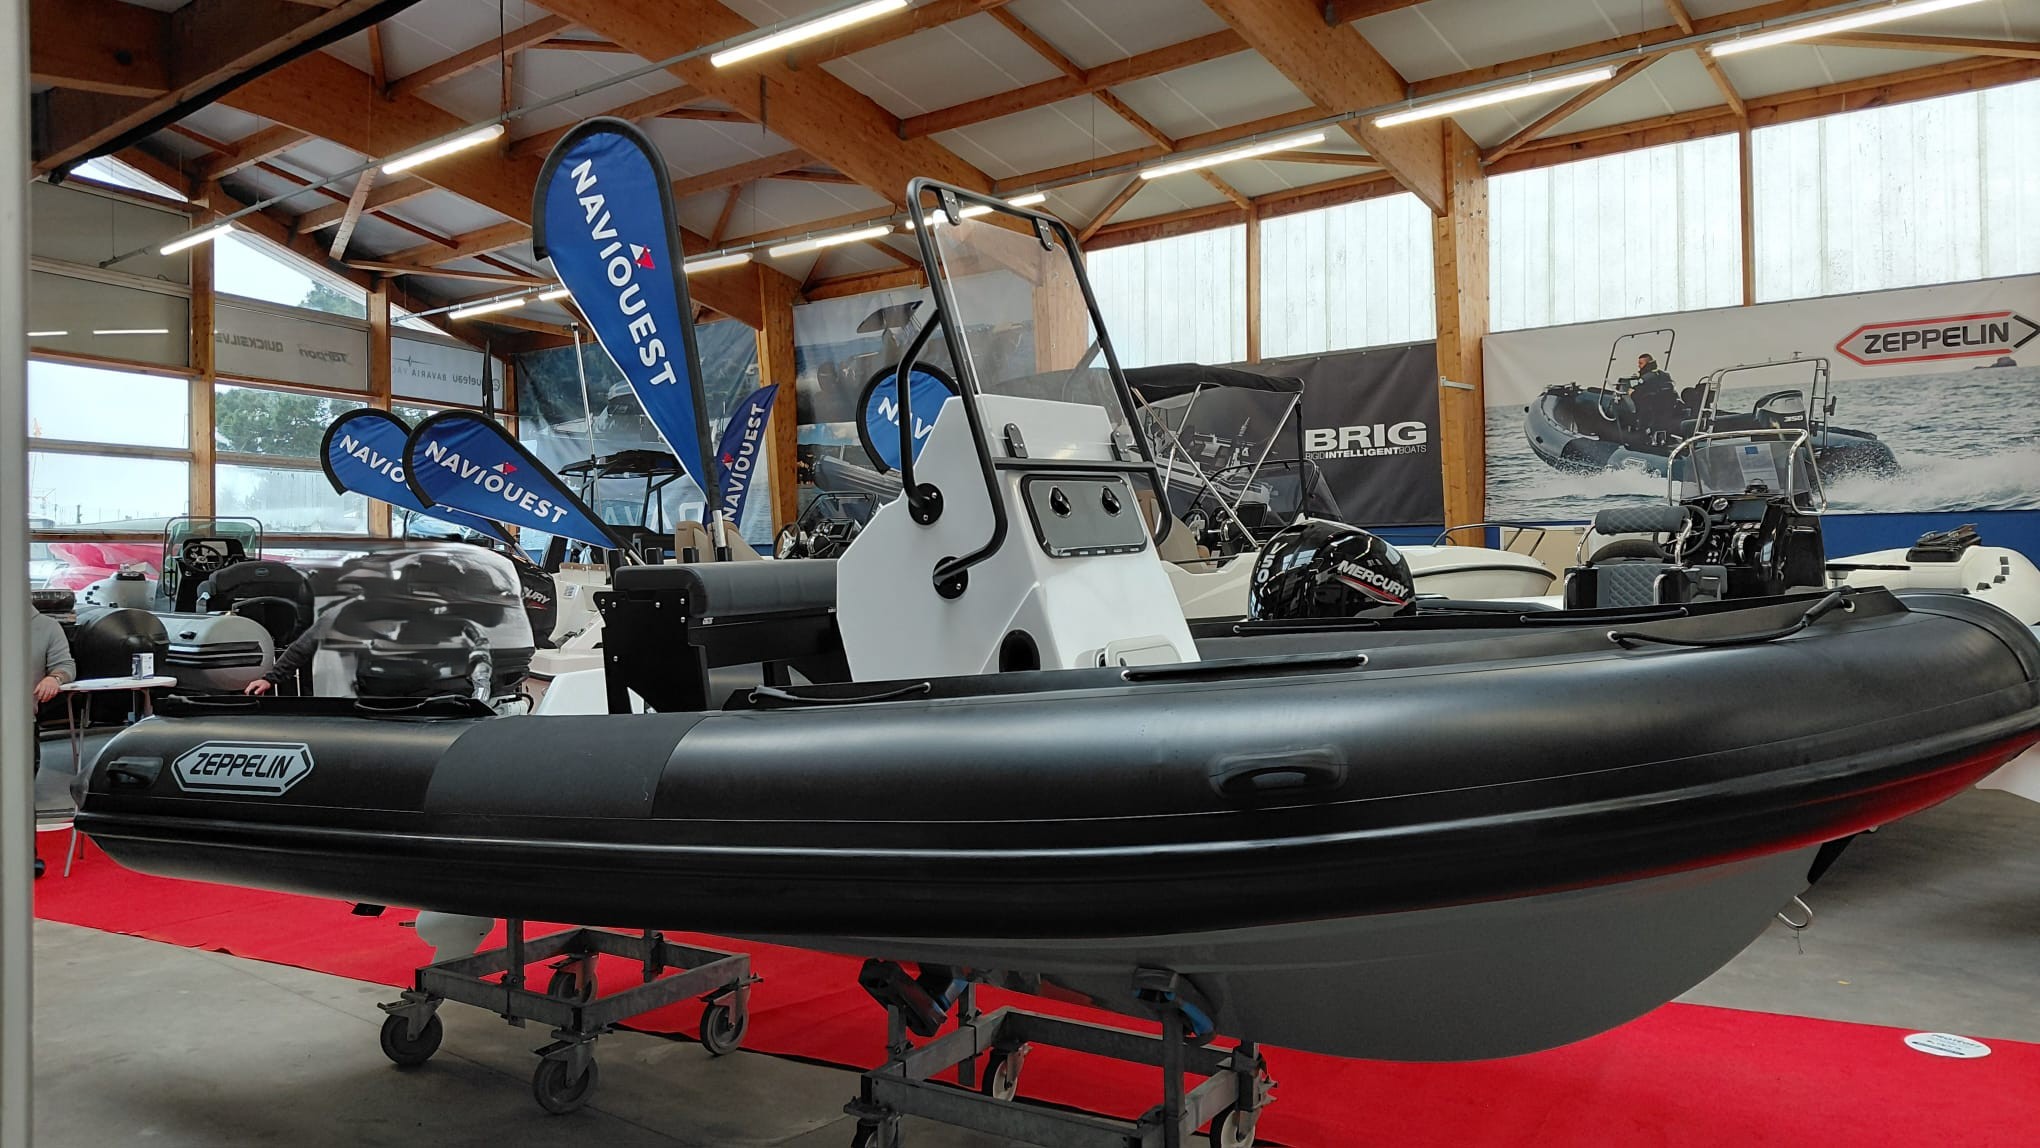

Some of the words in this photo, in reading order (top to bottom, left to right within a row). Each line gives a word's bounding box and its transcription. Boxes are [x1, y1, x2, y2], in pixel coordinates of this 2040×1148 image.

[571, 158, 677, 386] NAVIOUEST
[1864, 321, 2009, 354] ZEPPELIN
[1304, 421, 1427, 452] BRIG
[722, 403, 766, 522] NAVIOUEST
[424, 440, 568, 524] NAVIOUEST
[1337, 560, 1409, 598] MERCURY
[189, 752, 296, 779] ZEPPELIN
